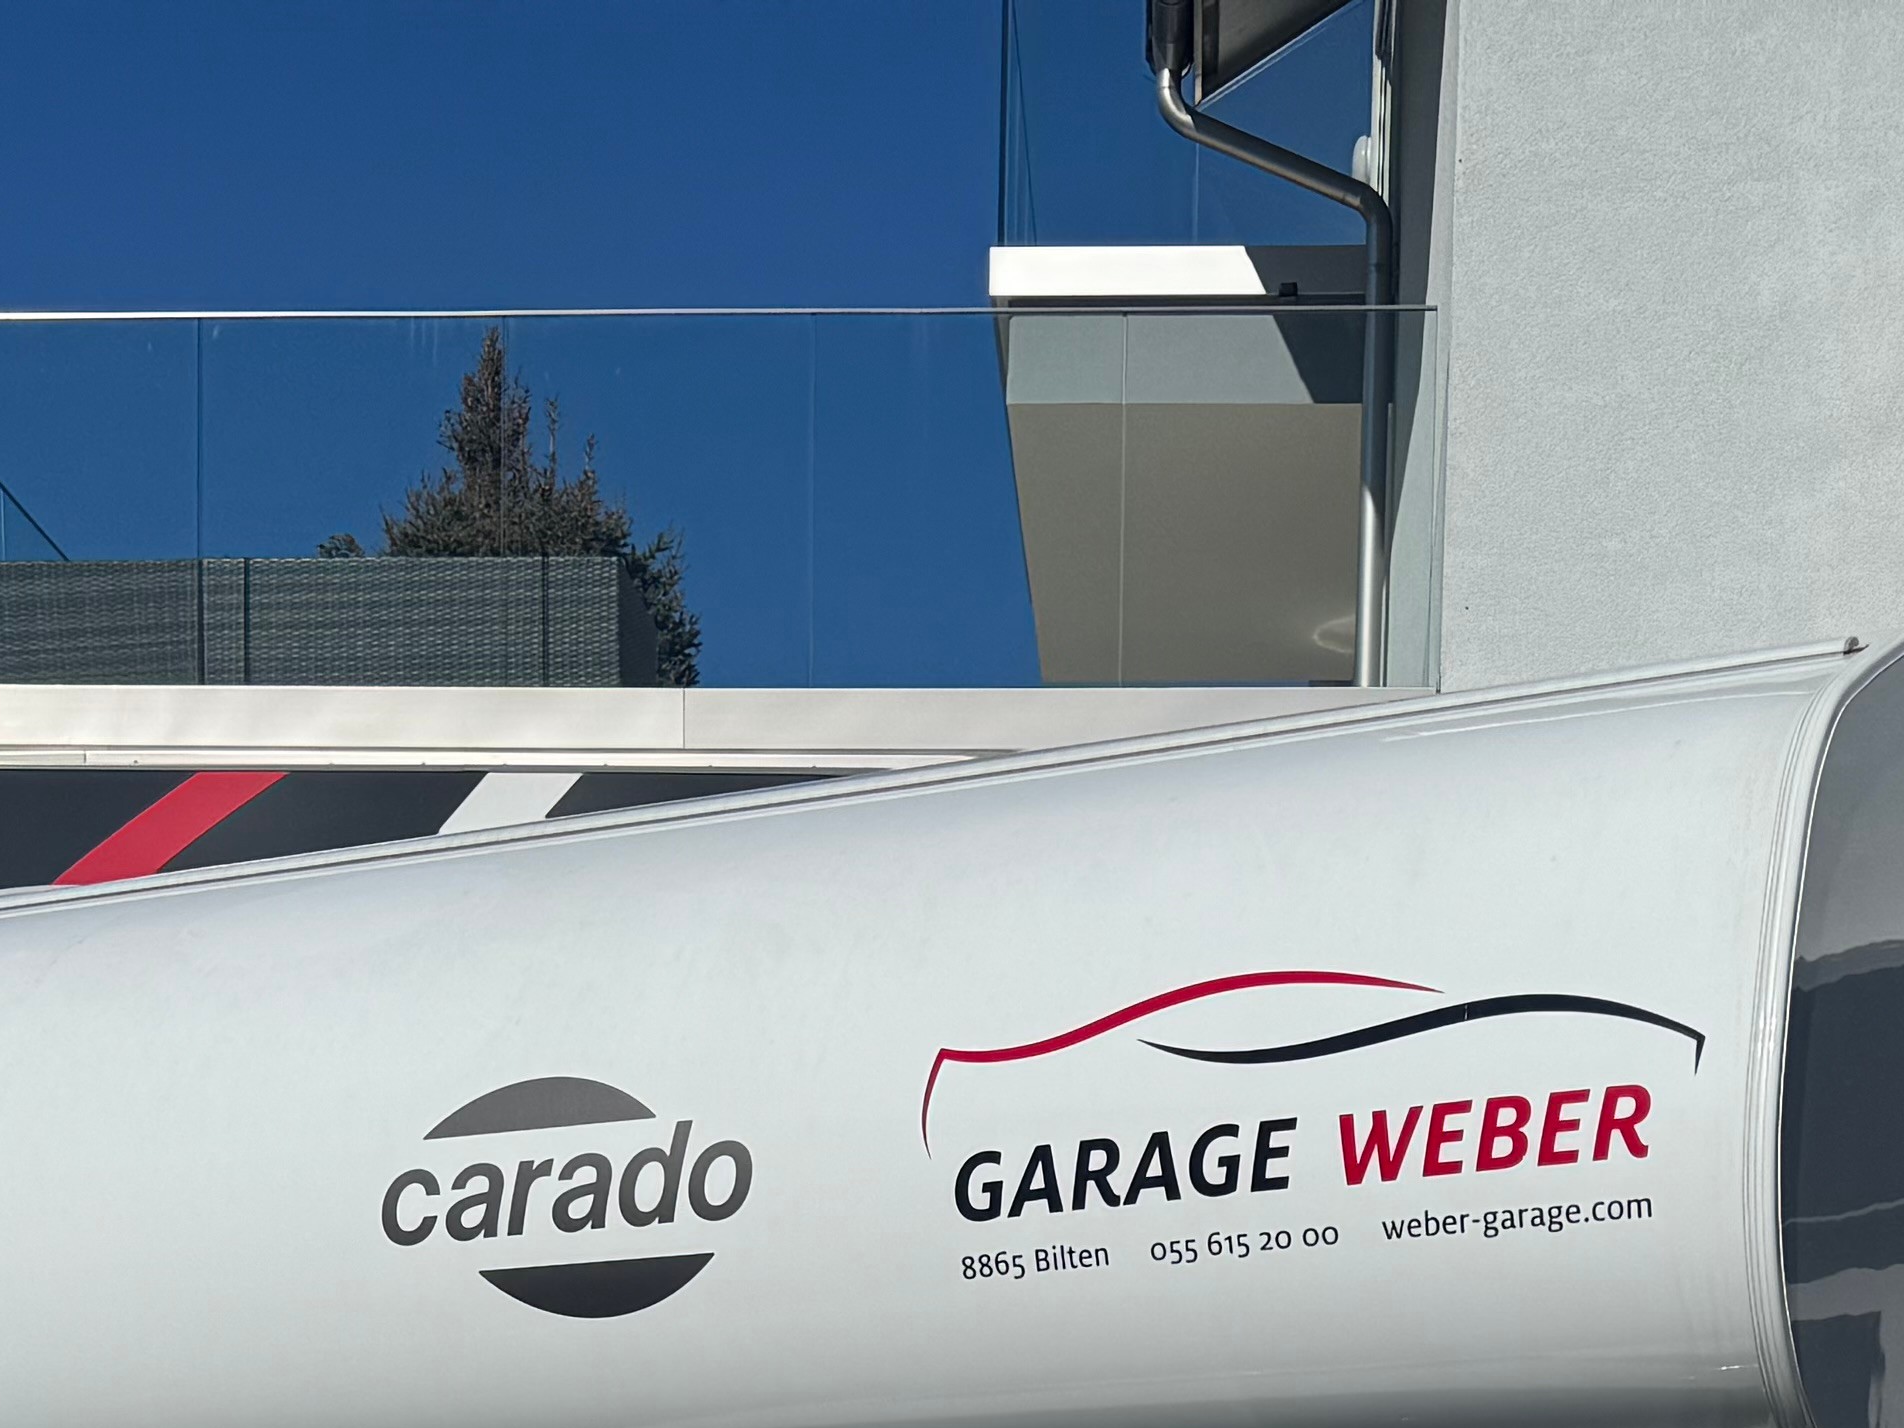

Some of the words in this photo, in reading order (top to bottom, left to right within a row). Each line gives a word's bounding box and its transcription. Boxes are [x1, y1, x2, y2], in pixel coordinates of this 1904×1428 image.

[380, 1118, 754, 1248] carado
[953, 1115, 1299, 1223] GARAGE
[1338, 1084, 1653, 1187] WEBER
[960, 1250, 1027, 1281] 8865
[1033, 1243, 1111, 1274] Bilten
[1149, 1237, 1199, 1266] 055
[1206, 1230, 1251, 1260] 615
[1257, 1229, 1293, 1252] 20
[1301, 1225, 1340, 1248] 00
[1380, 1196, 1654, 1241] weber-garage.com
